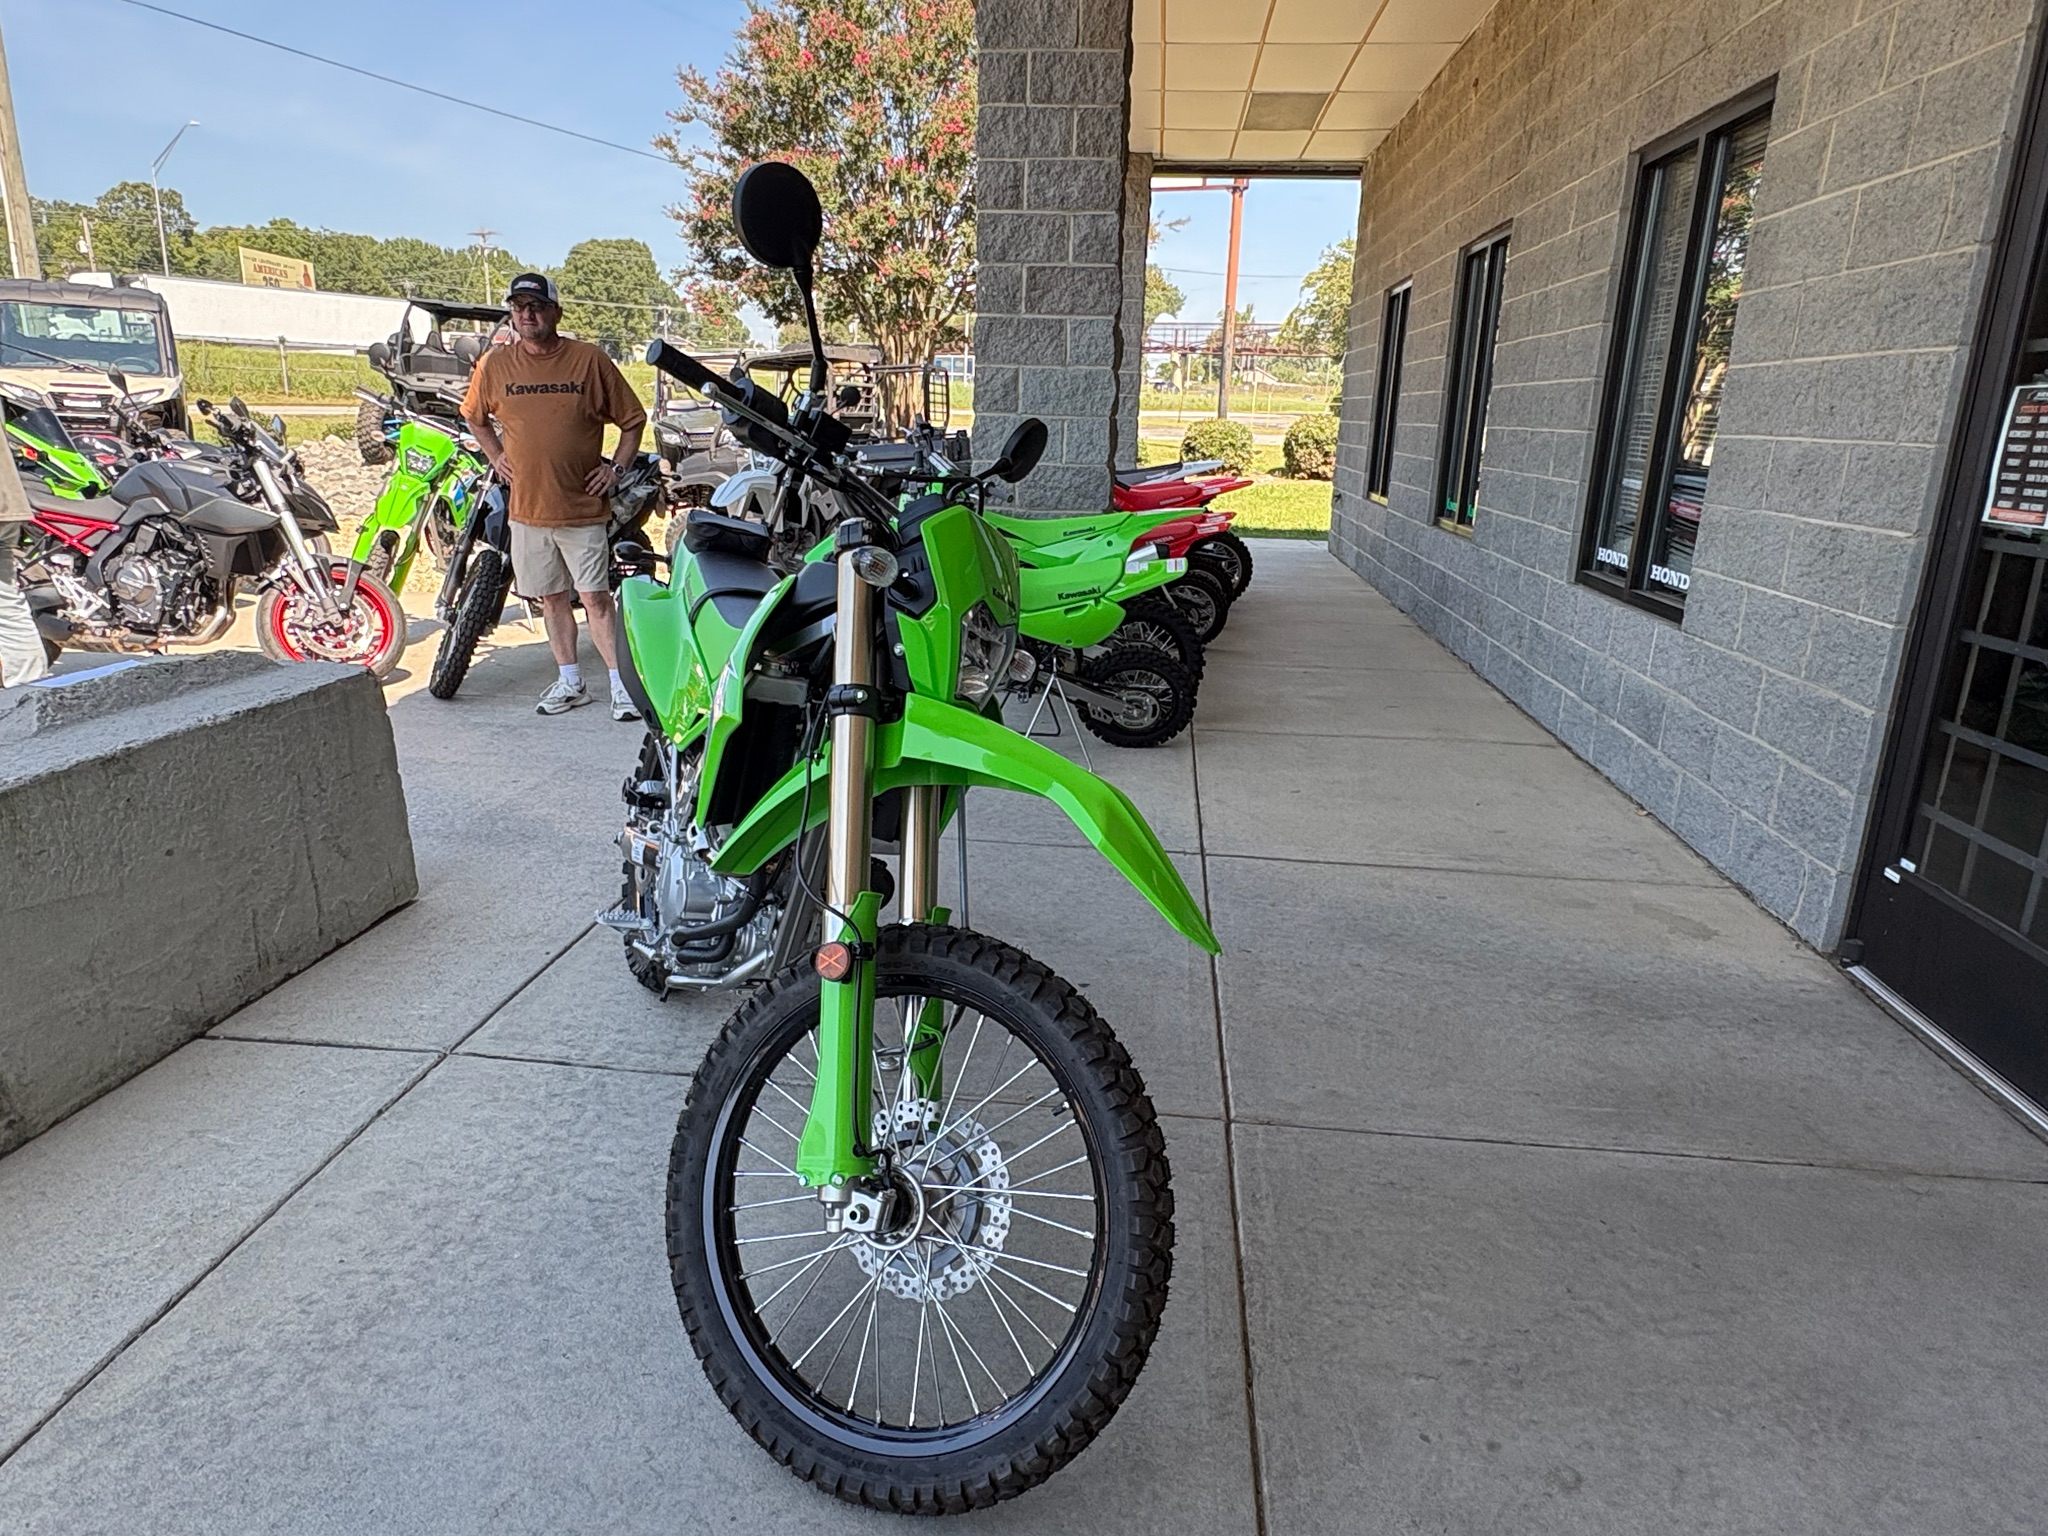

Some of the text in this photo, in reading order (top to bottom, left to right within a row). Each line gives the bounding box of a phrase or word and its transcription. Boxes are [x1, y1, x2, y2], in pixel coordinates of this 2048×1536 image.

[505, 381, 585, 397] Kawasaki
[1597, 547, 1628, 569] HOND
[1058, 586, 1101, 601] Kawasaki
